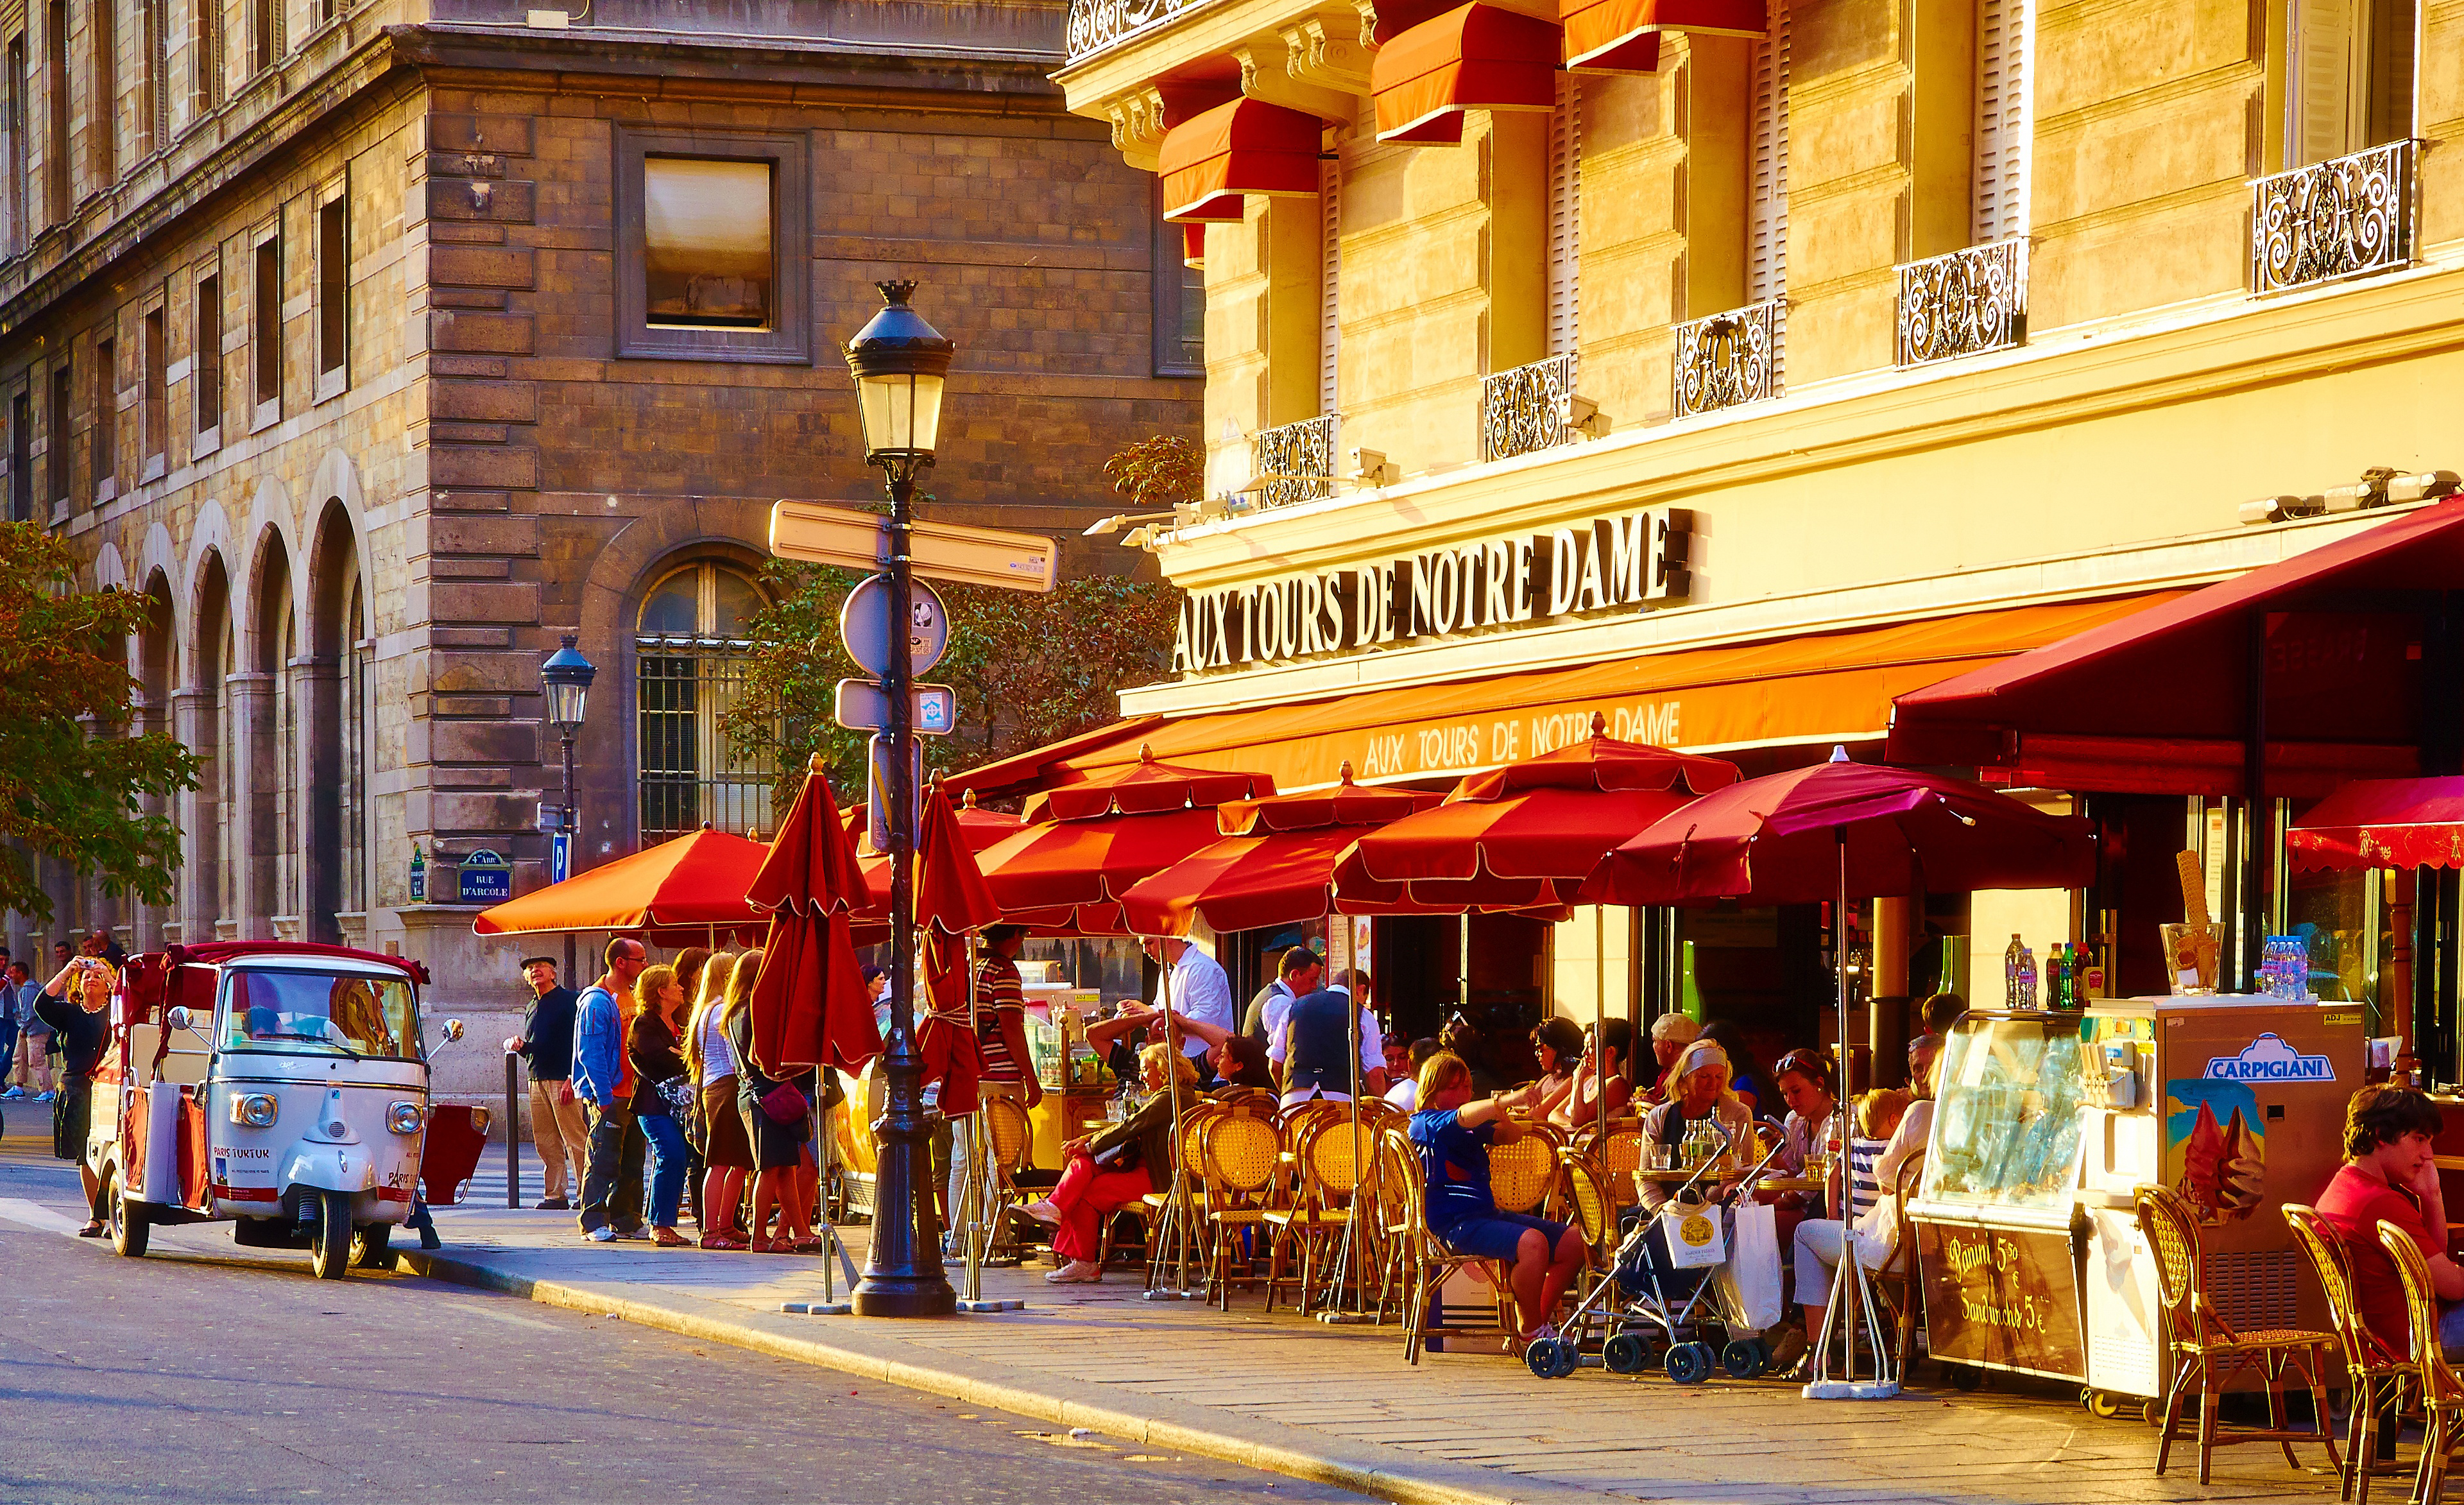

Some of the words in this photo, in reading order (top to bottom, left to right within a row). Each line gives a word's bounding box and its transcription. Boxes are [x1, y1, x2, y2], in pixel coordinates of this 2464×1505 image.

[1169, 590, 1232, 674] AUX
[1236, 571, 1344, 664] TOURS
[1353, 560, 1396, 647] DE
[1407, 535, 1535, 637] NOTRE
[1546, 508, 1670, 616] DAME
[1363, 734, 1405, 776] AUX
[1418, 723, 1479, 768] TOURS
[1492, 719, 1519, 762] DE
[556, 845, 563, 881] P
[462, 887, 508, 897] D'ARCOLE
[476, 875, 494, 884] RUE
[2212, 1060, 2323, 1078] CARPIGIANI
[214, 1146, 230, 1158] PARIS
[1949, 1231, 1992, 1283] Panini
